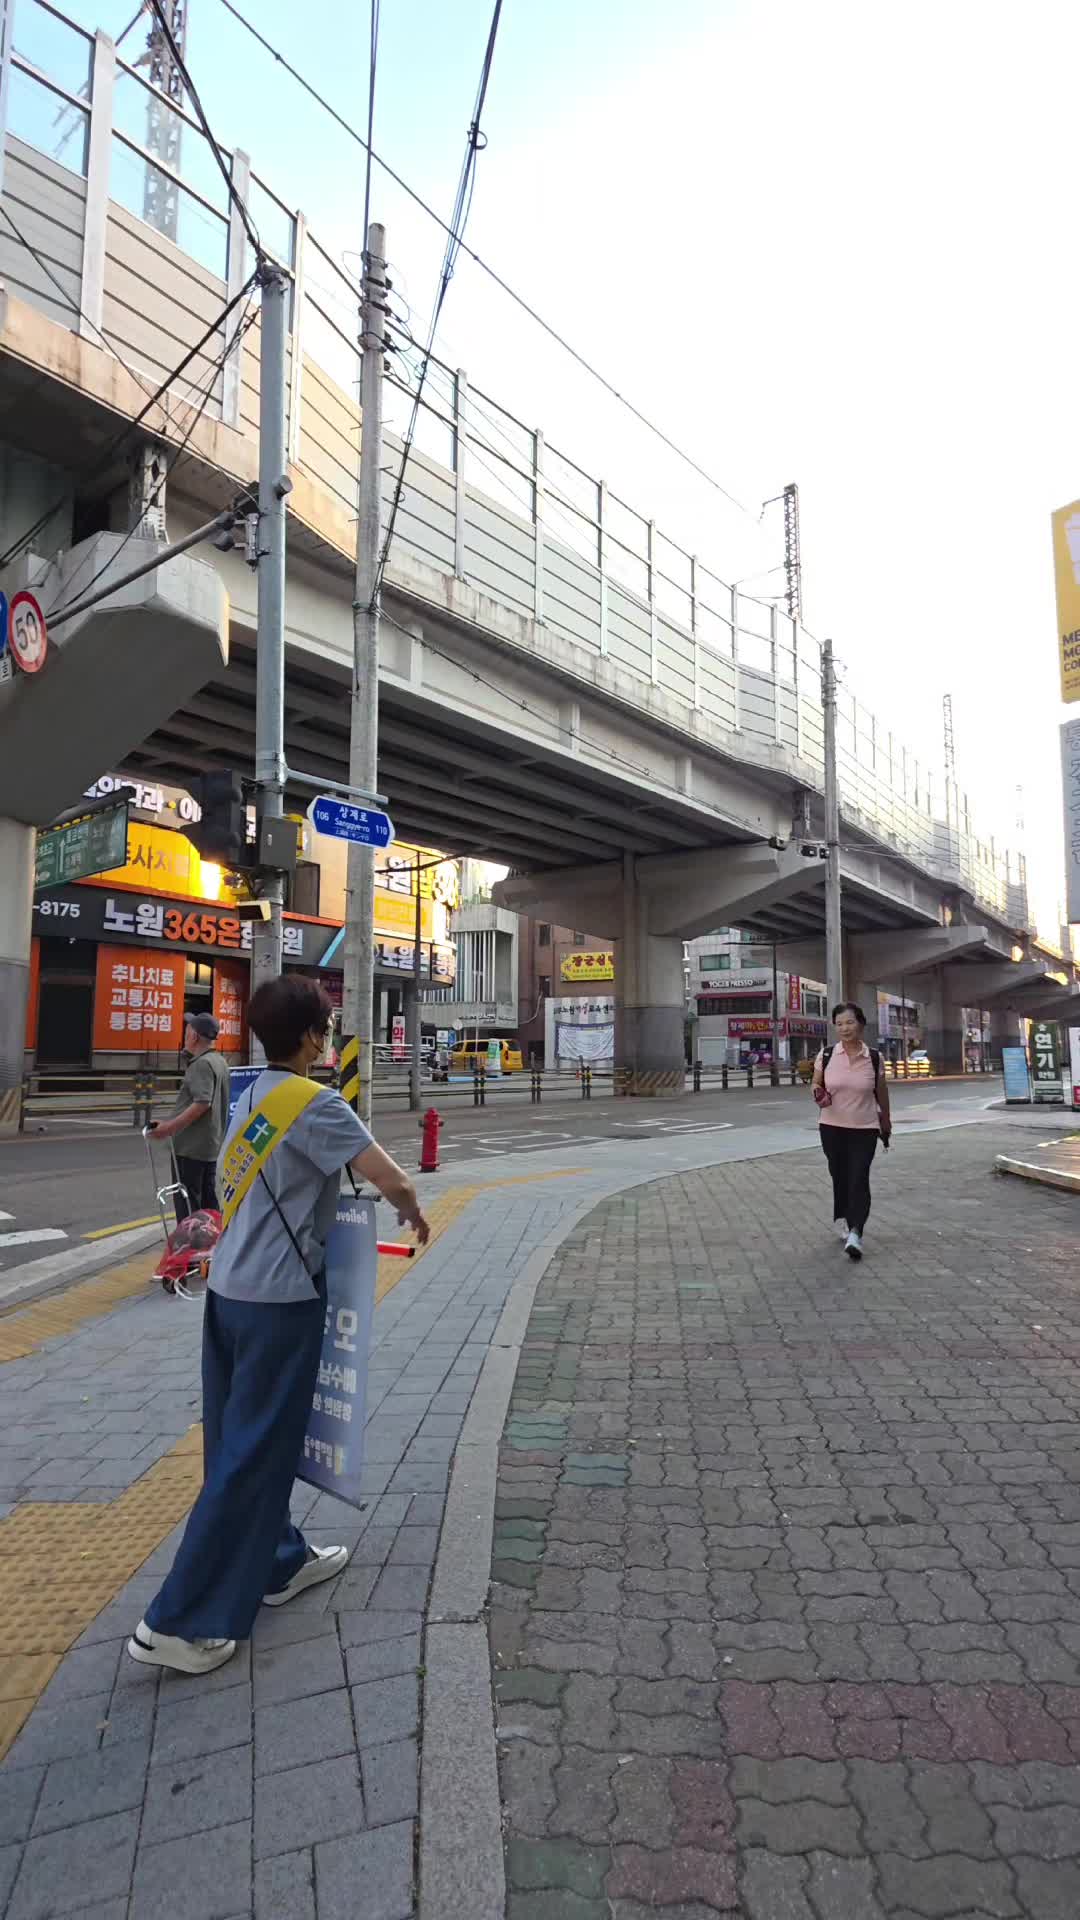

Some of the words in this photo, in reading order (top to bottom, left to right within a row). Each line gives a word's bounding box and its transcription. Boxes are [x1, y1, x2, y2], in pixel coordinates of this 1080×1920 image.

[16, 611, 38, 650] 50
[316, 811, 329, 821] 106
[339, 806, 368, 822] 상계로
[375, 825, 388, 836] 110
[111, 964, 174, 986] 추나치료
[110, 987, 173, 1009] 교통사고
[109, 1011, 172, 1031] 통증약침
